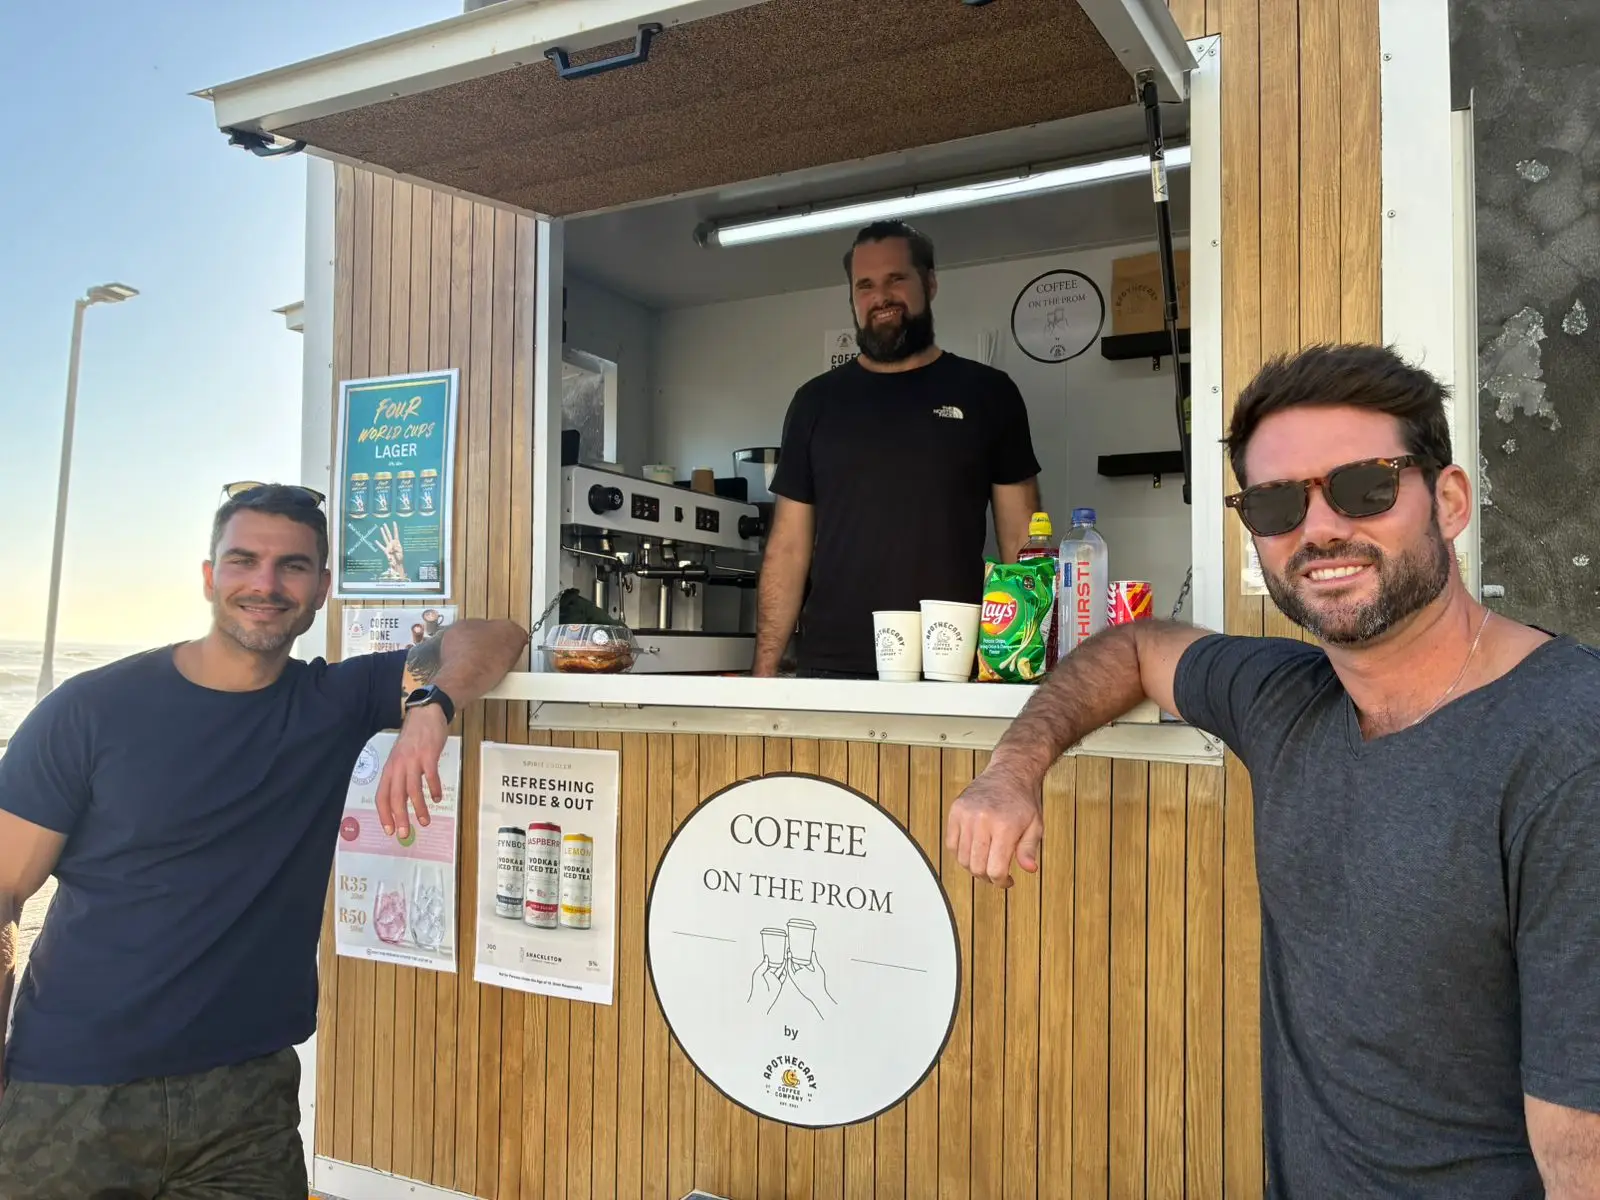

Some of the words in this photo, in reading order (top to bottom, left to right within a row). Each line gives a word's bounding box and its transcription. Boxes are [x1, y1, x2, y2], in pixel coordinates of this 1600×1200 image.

[1036, 280, 1078, 293] COFFEE
[1044, 297, 1060, 307] THE
[1061, 293, 1086, 304] PROM
[831, 353, 857, 365] COFF
[358, 424, 402, 442] WORLD
[403, 421, 436, 440] CUPS
[375, 443, 417, 459] LAGER
[981, 600, 1016, 625] Lay's
[370, 617, 399, 629] COFFEE
[370, 630, 391, 641] DONE
[926, 621, 963, 642] APOTHECARY
[523, 760, 544, 768] SPIRIT
[502, 775, 594, 794] REFRESHING
[501, 791, 547, 807] INSIDE
[550, 796, 560, 808] &
[564, 797, 594, 811] OUT
[730, 813, 867, 857] COFFEE
[564, 847, 591, 857] LEMON
[499, 857, 520, 865] VODKA
[529, 857, 552, 866] VODKA
[529, 865, 543, 873] ICED
[545, 867, 558, 875] TEA
[564, 865, 586, 873] VODKA
[340, 875, 368, 893] R35
[703, 868, 741, 894] ON
[749, 873, 804, 902] THE
[811, 881, 893, 914] PROM
[339, 907, 367, 925] R50
[526, 951, 562, 963] SHACKLETON
[784, 1025, 799, 1041] by
[763, 1055, 817, 1090] APOTHECARY
[775, 1091, 803, 1102] COMPANY
[778, 1086, 800, 1096] COFFEE
